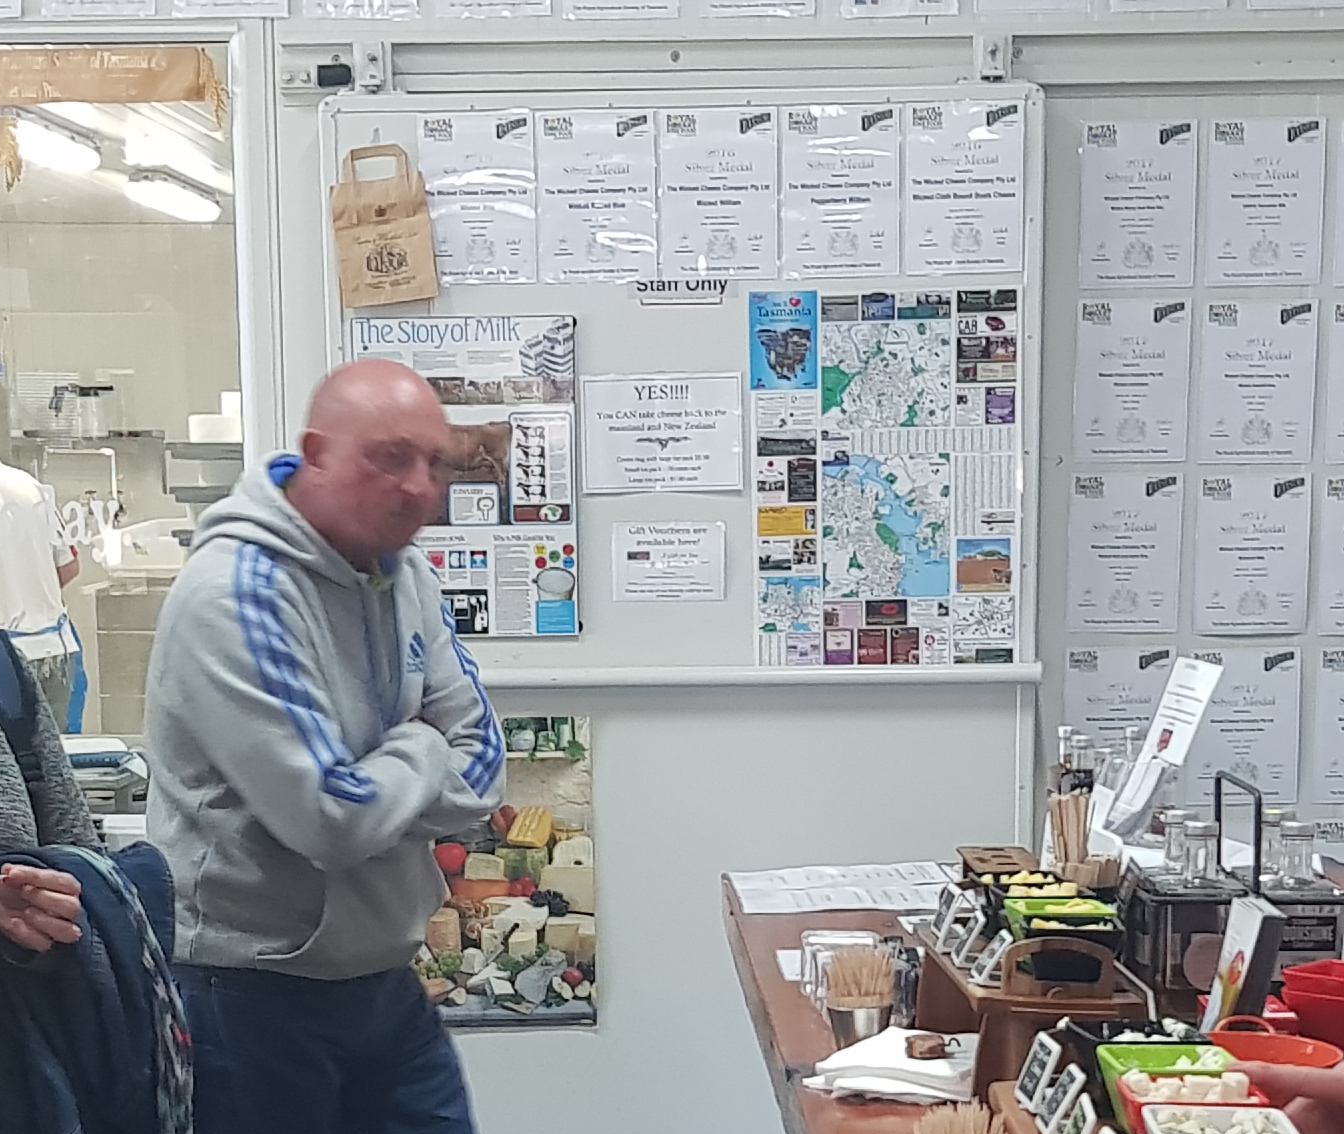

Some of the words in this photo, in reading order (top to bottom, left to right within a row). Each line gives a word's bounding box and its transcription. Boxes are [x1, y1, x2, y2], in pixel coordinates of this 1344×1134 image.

[686, 280, 728, 295] Only
[757, 306, 812, 317] Tasmania
[356, 317, 394, 344] The
[397, 321, 449, 348] Story
[451, 317, 471, 342] of
[475, 317, 521, 342] Milk
[958, 320, 978, 335] CAR
[634, 384, 690, 401] YES!!!!
[596, 412, 614, 420] You
[615, 411, 637, 419] CAN
[646, 422, 661, 431] and
[664, 422, 682, 431] New
[684, 421, 716, 430] Zealand
[648, 526, 690, 535] Vouchers
[637, 538, 675, 546] available
